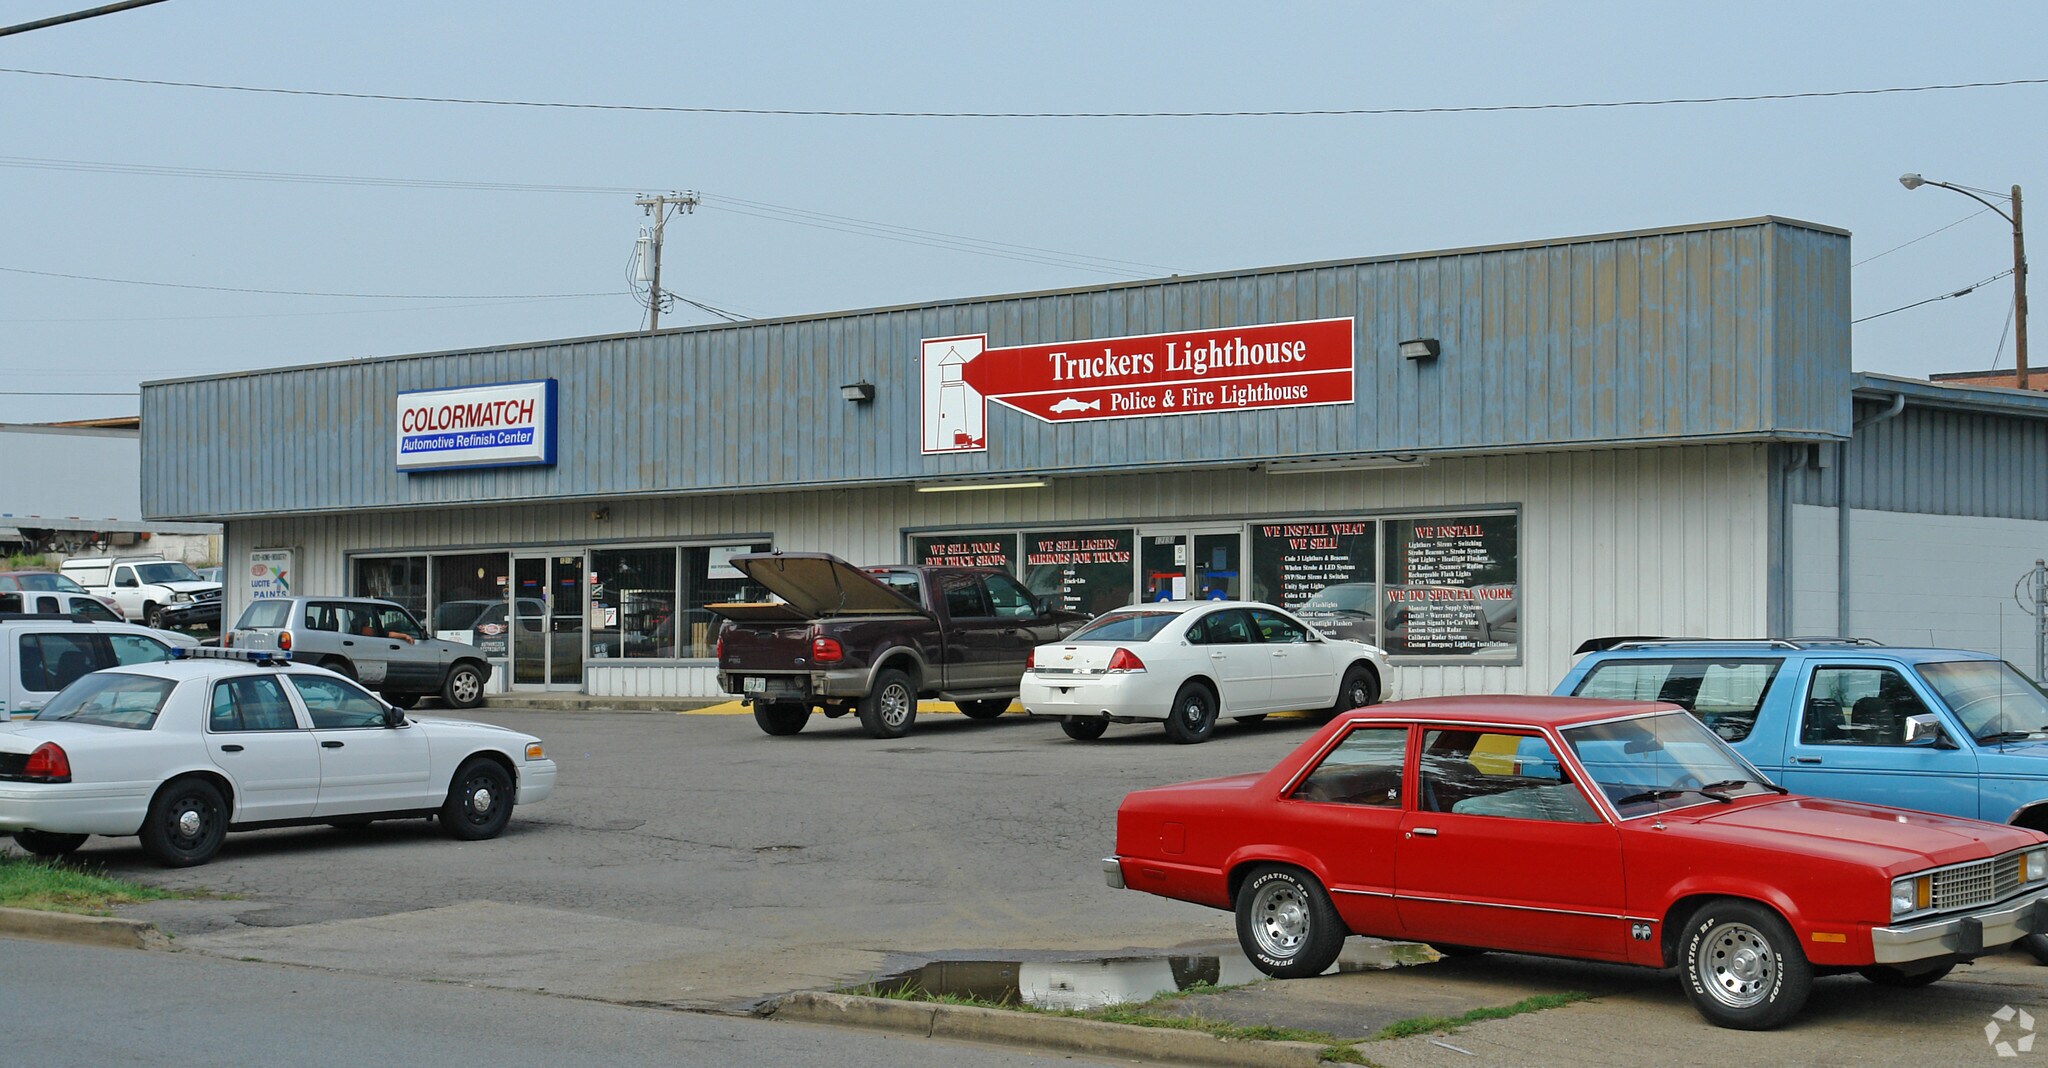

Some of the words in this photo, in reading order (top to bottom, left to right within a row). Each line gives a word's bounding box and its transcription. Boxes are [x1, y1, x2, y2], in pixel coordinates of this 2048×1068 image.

[1049, 349, 1154, 381] Truckers
[1165, 336, 1306, 375] Lighthouse
[1111, 389, 1156, 411] Police
[1162, 390, 1175, 407] &
[1182, 387, 1215, 406] Fire
[1220, 381, 1308, 404] Lighthouse
[402, 399, 535, 432] COLORMATCH
[403, 437, 454, 451] Automotive
[456, 434, 495, 447] Refinish
[497, 431, 531, 444] Center
[1263, 526, 1280, 537] WE
[1284, 524, 1328, 536] INSTALL
[1331, 523, 1365, 535] WHAT
[1415, 527, 1433, 538] WE
[1437, 525, 1483, 538] INSTALL
[931, 544, 945, 555] WE
[947, 544, 969, 554] SELL
[971, 543, 1000, 553] TOOLS
[1038, 541, 1053, 551] WE
[1056, 540, 1079, 550] SELL
[1081, 539, 1118, 550] LIGHTS/
[1289, 539, 1307, 549] WE
[1310, 538, 1337, 549] SELL
[925, 557, 942, 565] FOR
[945, 556, 974, 566] TRUCK
[976, 555, 1005, 565] SHOPS
[1028, 553, 1070, 565] MIRRORS
[1073, 553, 1091, 564] FOR
[1093, 552, 1130, 563] TRUCKS
[1387, 590, 1405, 602] WE
[1409, 590, 1425, 601] DO
[1428, 589, 1475, 601] SPECIAL
[1478, 588, 1513, 600] WORK
[1253, 873, 1295, 889] CITATION
[1257, 954, 1293, 966] DUNLOP
[1689, 934, 1704, 994] CITATION
[1769, 953, 1783, 1003] DUNLOP
